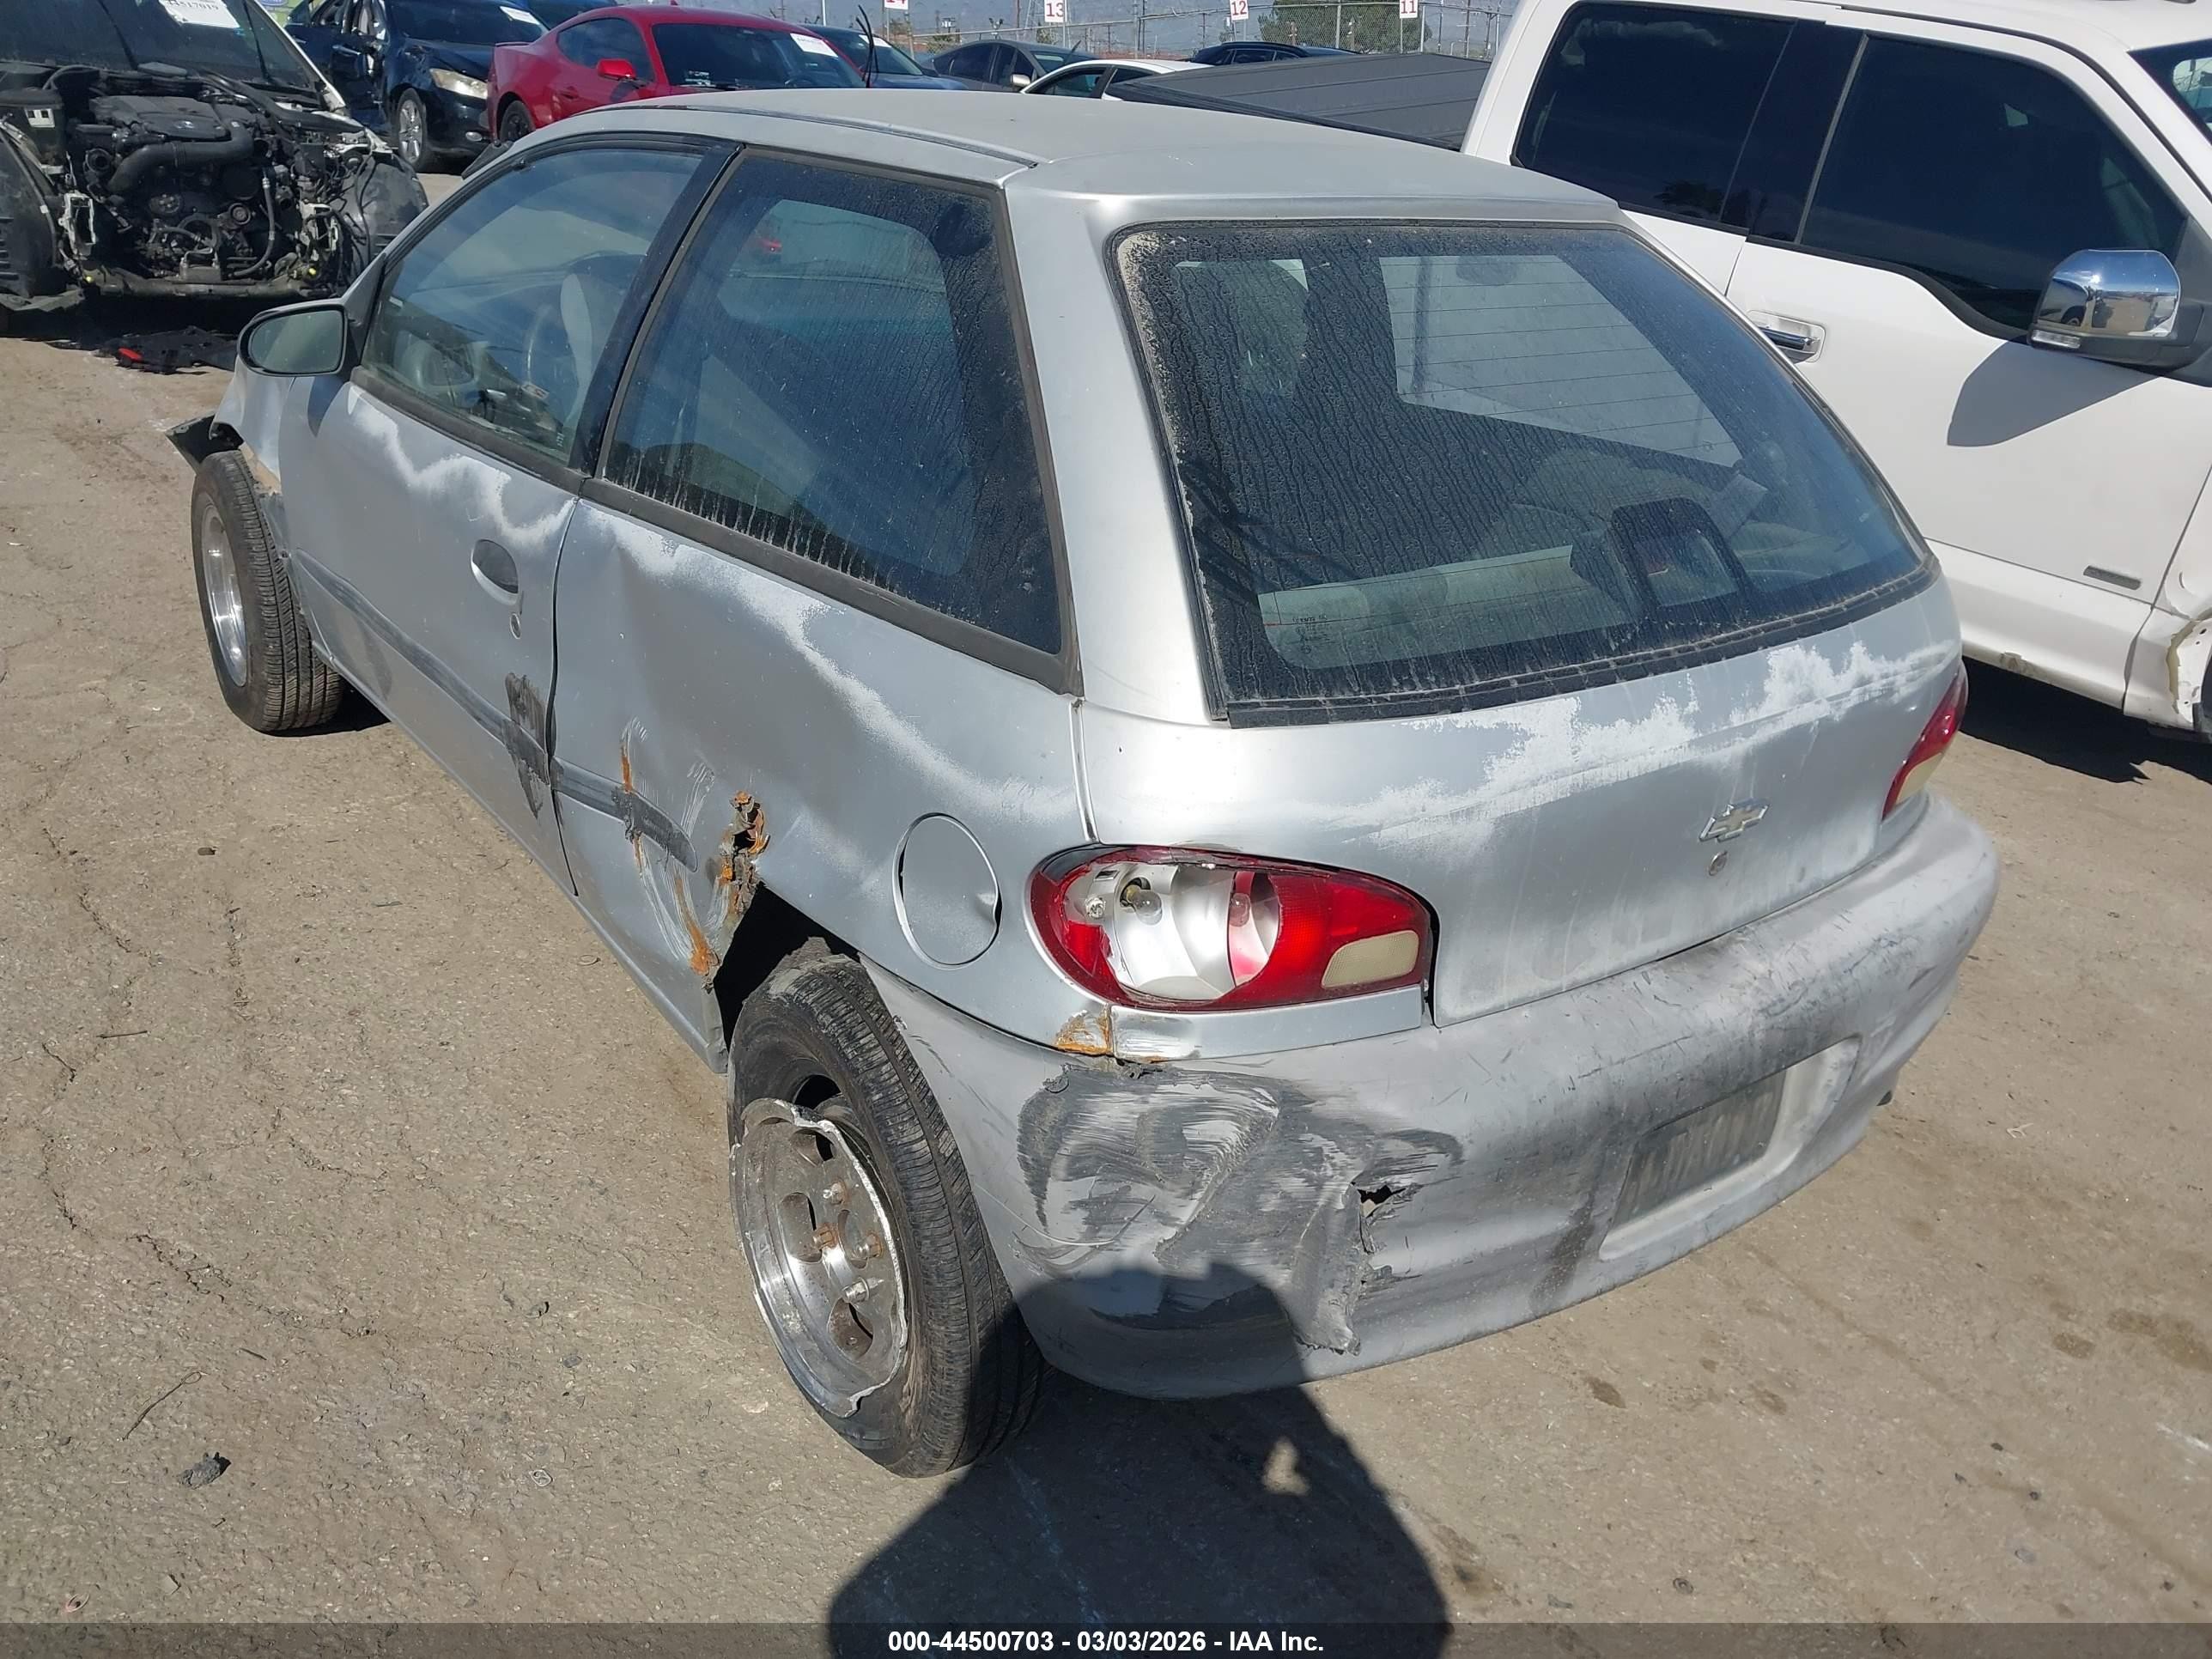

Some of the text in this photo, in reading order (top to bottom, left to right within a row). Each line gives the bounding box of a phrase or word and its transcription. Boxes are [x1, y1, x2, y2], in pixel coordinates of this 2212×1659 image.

[1046, 3, 1064, 17] 13
[1231, 0, 1247, 15] 12
[1401, 0, 1417, 14] 11
